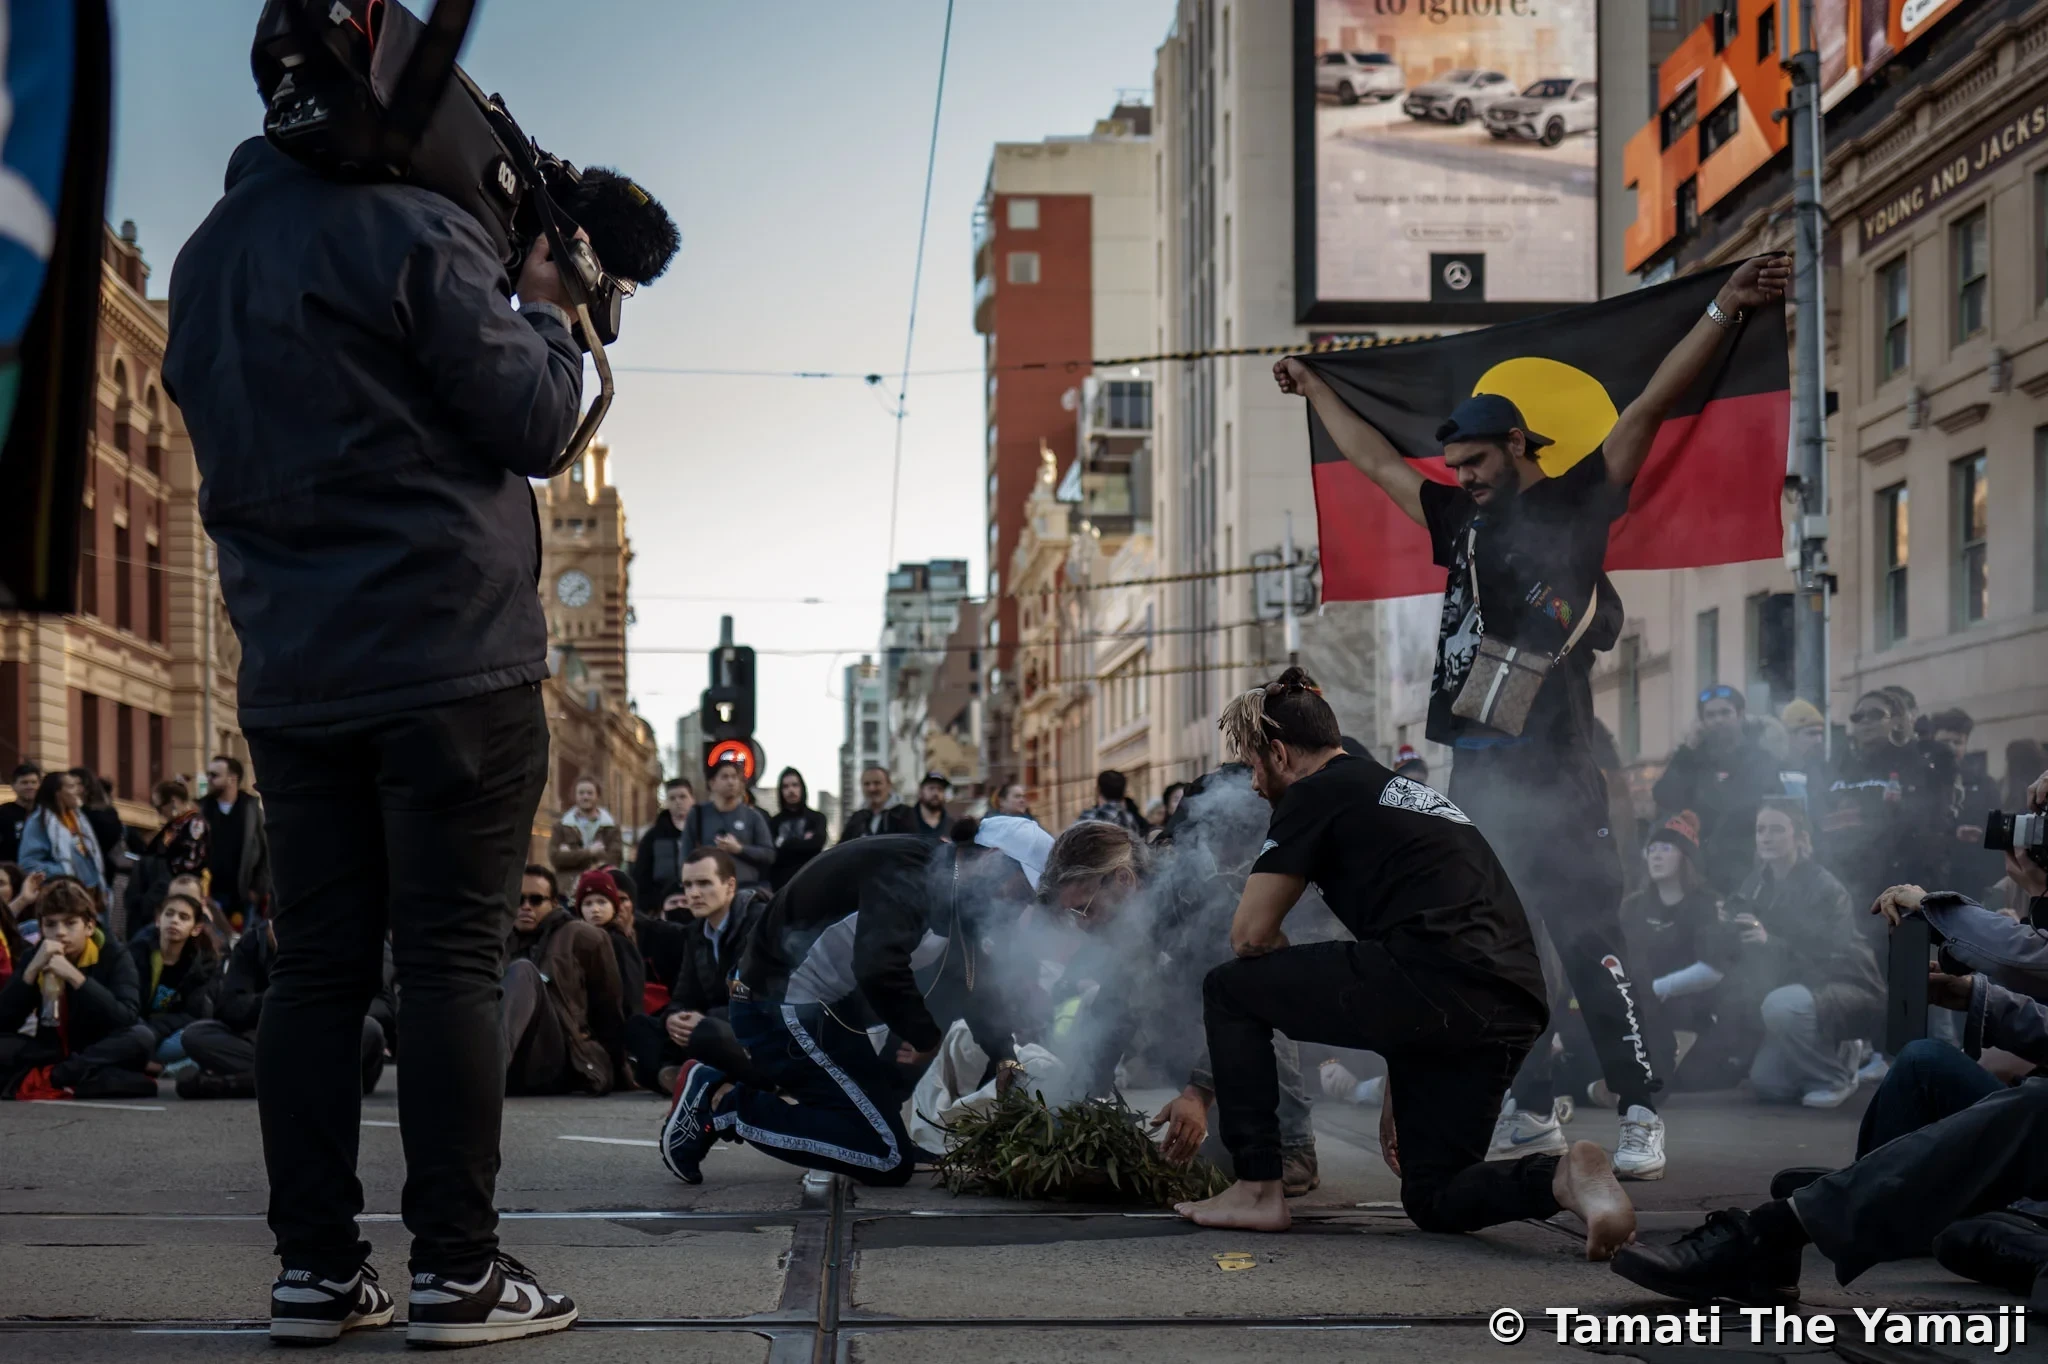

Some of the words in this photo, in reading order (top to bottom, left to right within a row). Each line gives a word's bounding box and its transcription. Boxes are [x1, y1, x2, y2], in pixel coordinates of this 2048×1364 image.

[1864, 186, 1924, 241] YOUNG
[1929, 155, 1970, 201] AND
[1974, 104, 2048, 170] JACKS
[1600, 954, 1654, 1084] Champion
[284, 1269, 312, 1281] NIKE
[414, 1272, 437, 1284] NIKE
